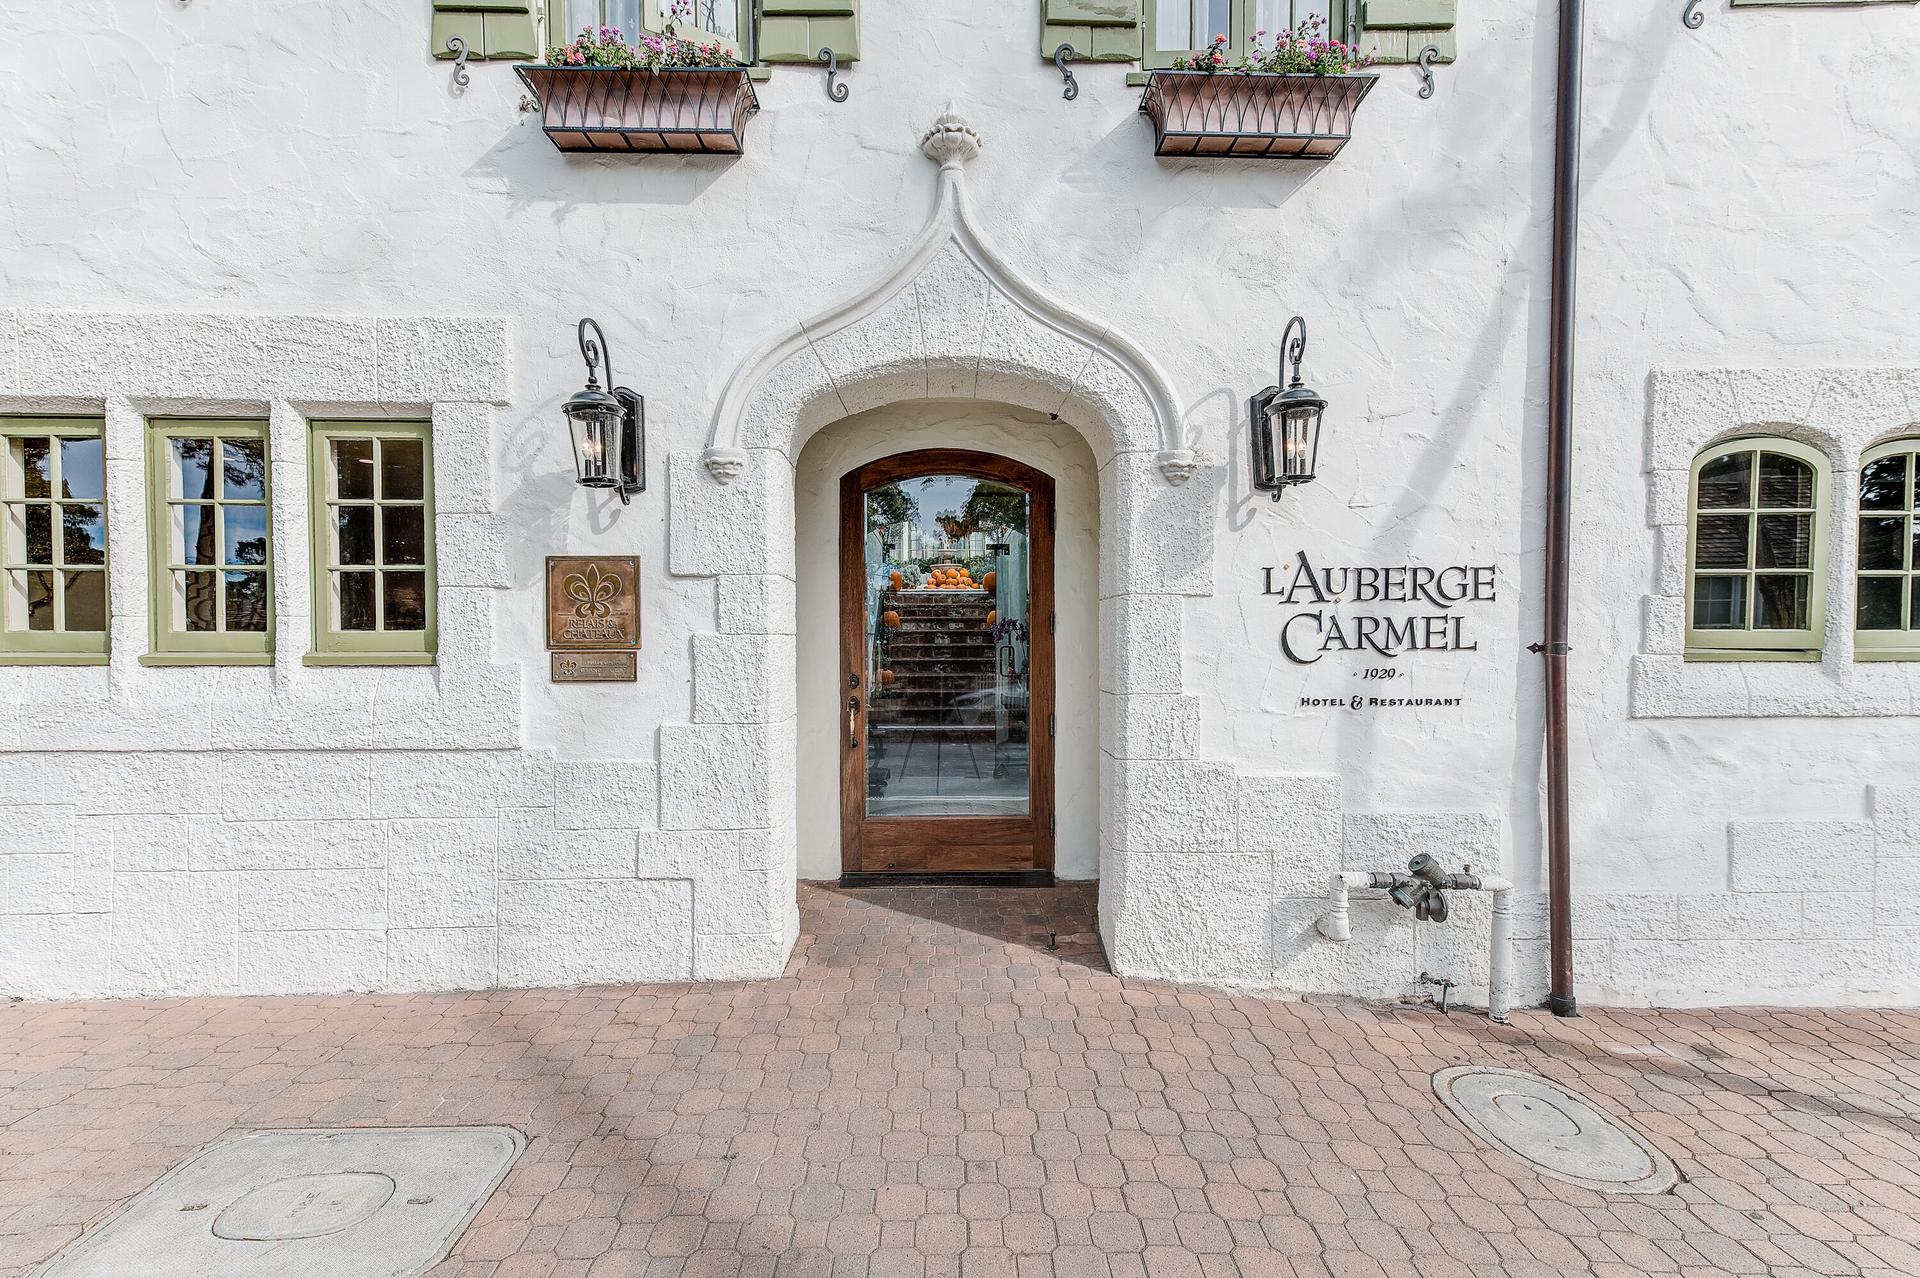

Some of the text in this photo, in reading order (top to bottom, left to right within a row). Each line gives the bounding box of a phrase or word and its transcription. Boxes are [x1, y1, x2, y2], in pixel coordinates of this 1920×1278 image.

[568, 619, 617, 629] RELAIS &
[1281, 609, 1477, 664] CARMEL
[1362, 668, 1396, 680] 1929
[1350, 695, 1363, 710] &
